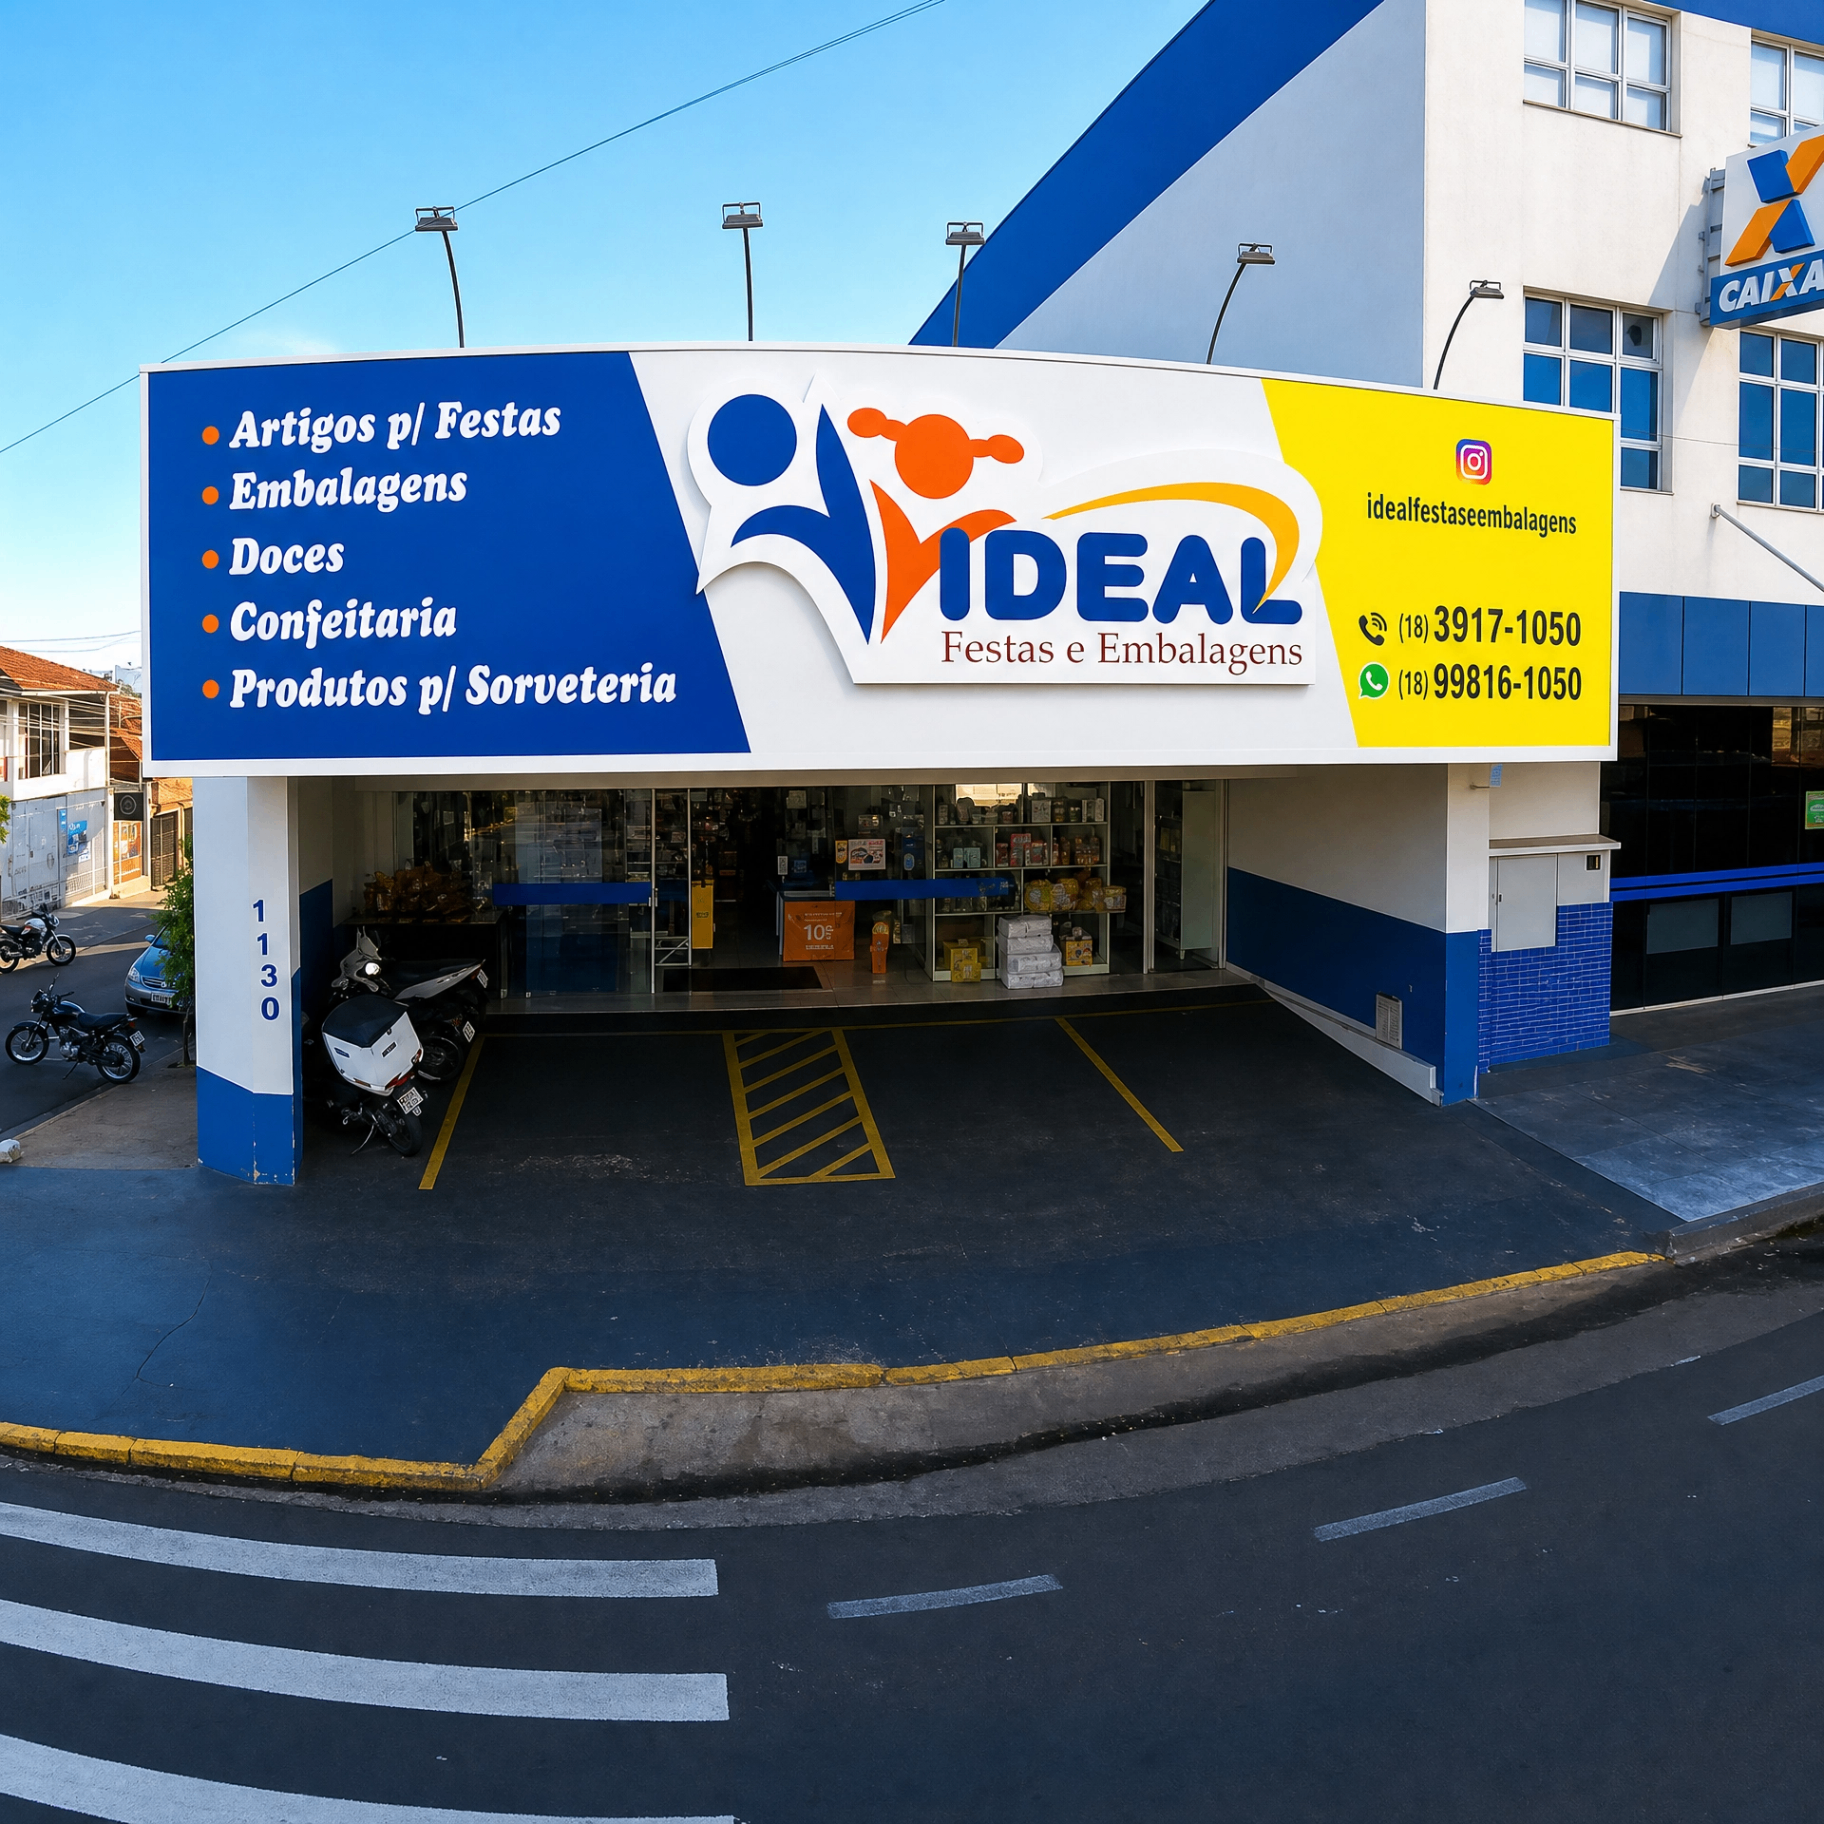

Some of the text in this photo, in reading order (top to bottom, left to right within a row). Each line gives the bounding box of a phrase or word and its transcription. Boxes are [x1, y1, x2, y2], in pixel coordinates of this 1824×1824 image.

[1719, 259, 1824, 312] CAIXA
[229, 402, 560, 453] Artigos p/ Festas
[229, 467, 467, 512] Embalagens
[1368, 492, 1576, 538] idealfestaseembalagens
[229, 538, 344, 575] Doces
[940, 527, 1302, 624] IDEAL
[231, 597, 456, 649] Confeitaria
[1399, 606, 1581, 646] (18) 3917-1050
[942, 631, 1302, 675] Festas e Embalagens
[230, 663, 676, 715] Produtos p/ Sorveteria
[1399, 663, 1581, 700] (18) 99816-1050
[252, 899, 279, 1020] 1130
